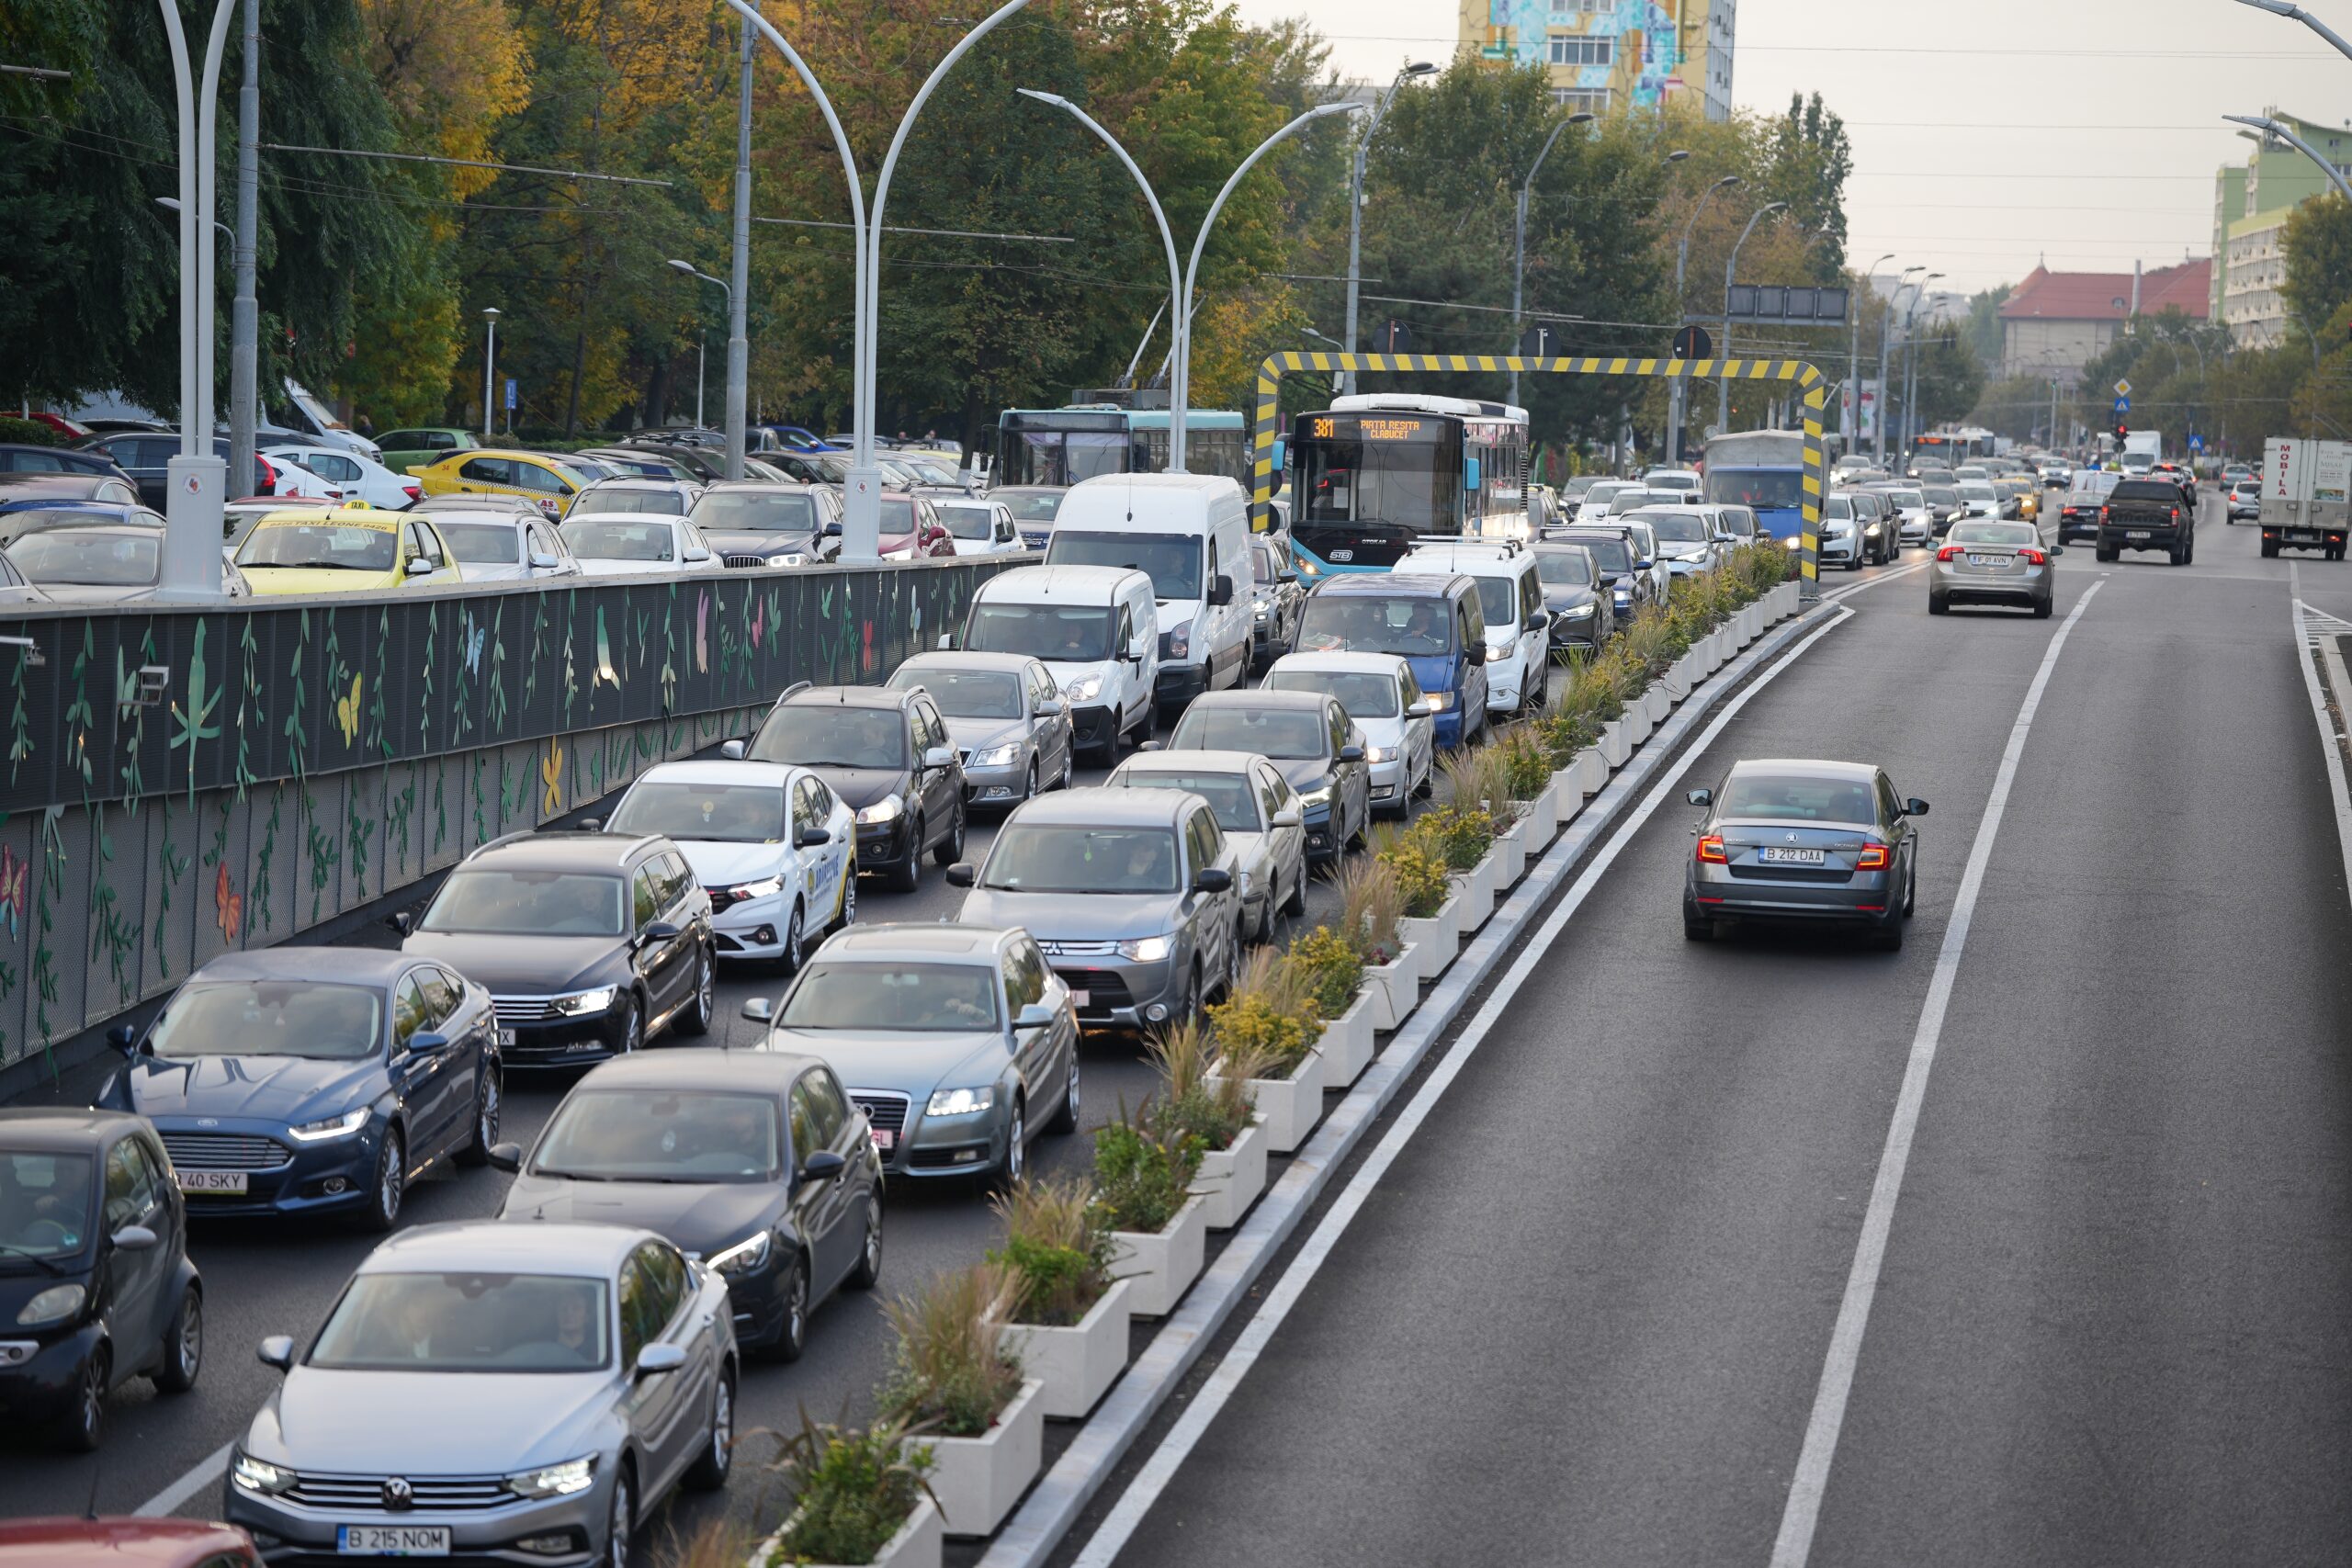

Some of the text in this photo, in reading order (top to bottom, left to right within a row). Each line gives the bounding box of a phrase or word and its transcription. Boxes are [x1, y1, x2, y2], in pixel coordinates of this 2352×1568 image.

[1314, 418, 1334, 437] 381
[1361, 420, 1419, 430] PIATA RESITA
[1370, 429, 1408, 439] CLABUCET
[2278, 445, 2290, 496] MOBILA
[351, 502, 365, 510] TAXI
[1768, 848, 1821, 862] B 212 DAA
[187, 1174, 204, 1188] 40
[209, 1174, 240, 1189] SKY
[349, 1529, 443, 1549] B 215 NOM
